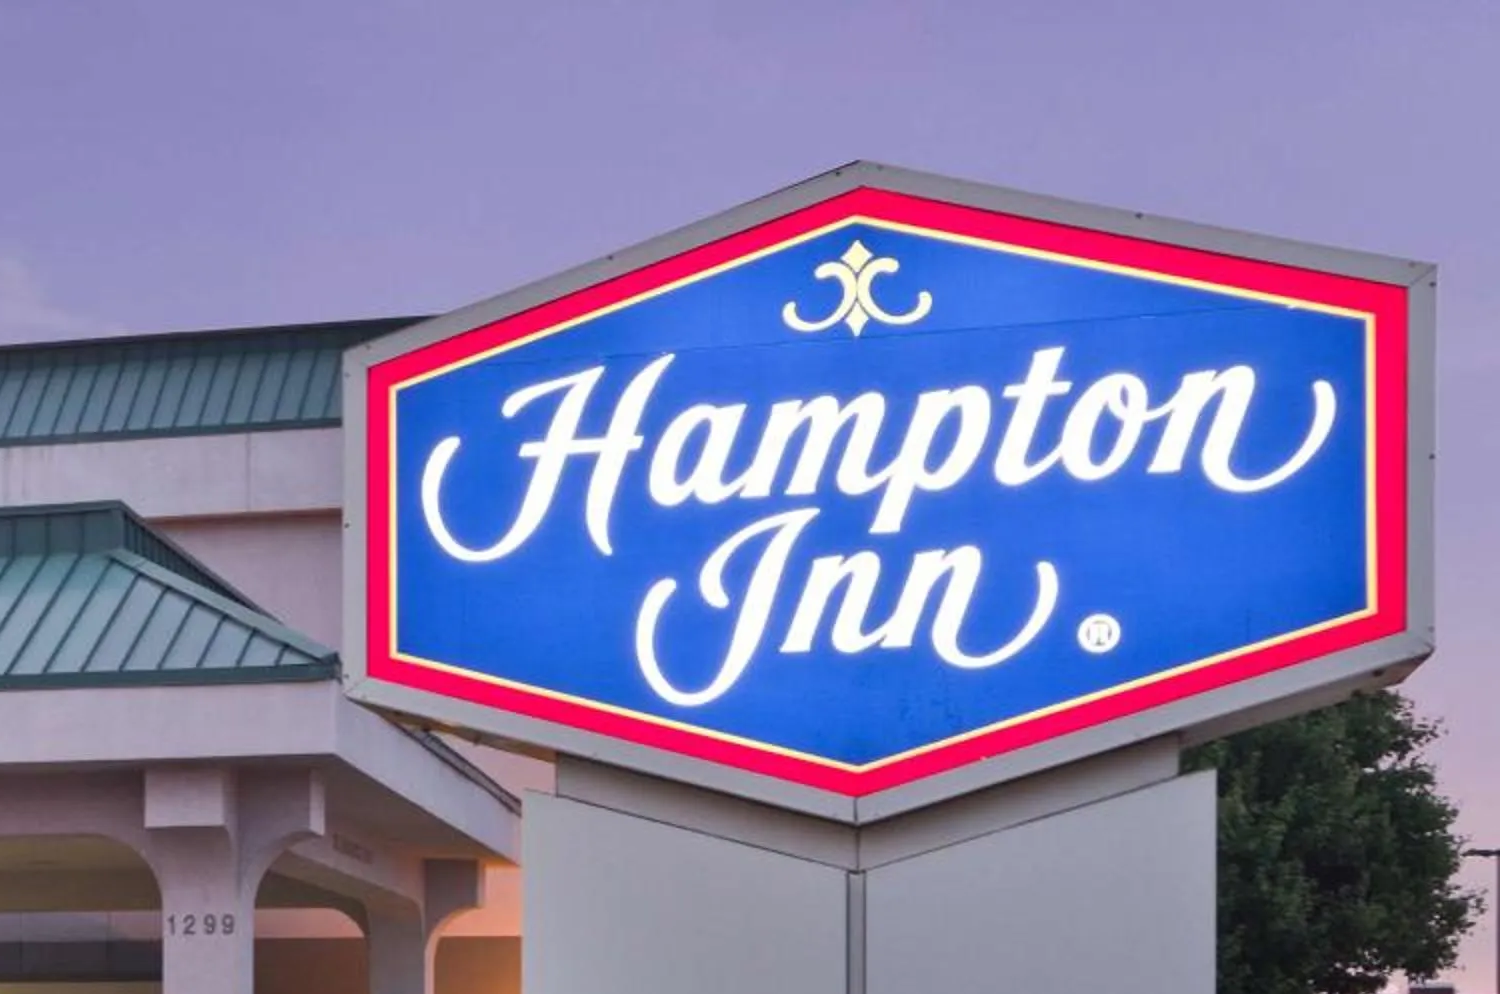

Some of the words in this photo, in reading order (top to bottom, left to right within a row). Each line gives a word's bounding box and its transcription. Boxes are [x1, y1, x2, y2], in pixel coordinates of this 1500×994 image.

[421, 346, 1336, 562] Hampton
[635, 507, 1059, 707] Inn
[166, 913, 236, 936] 1299
